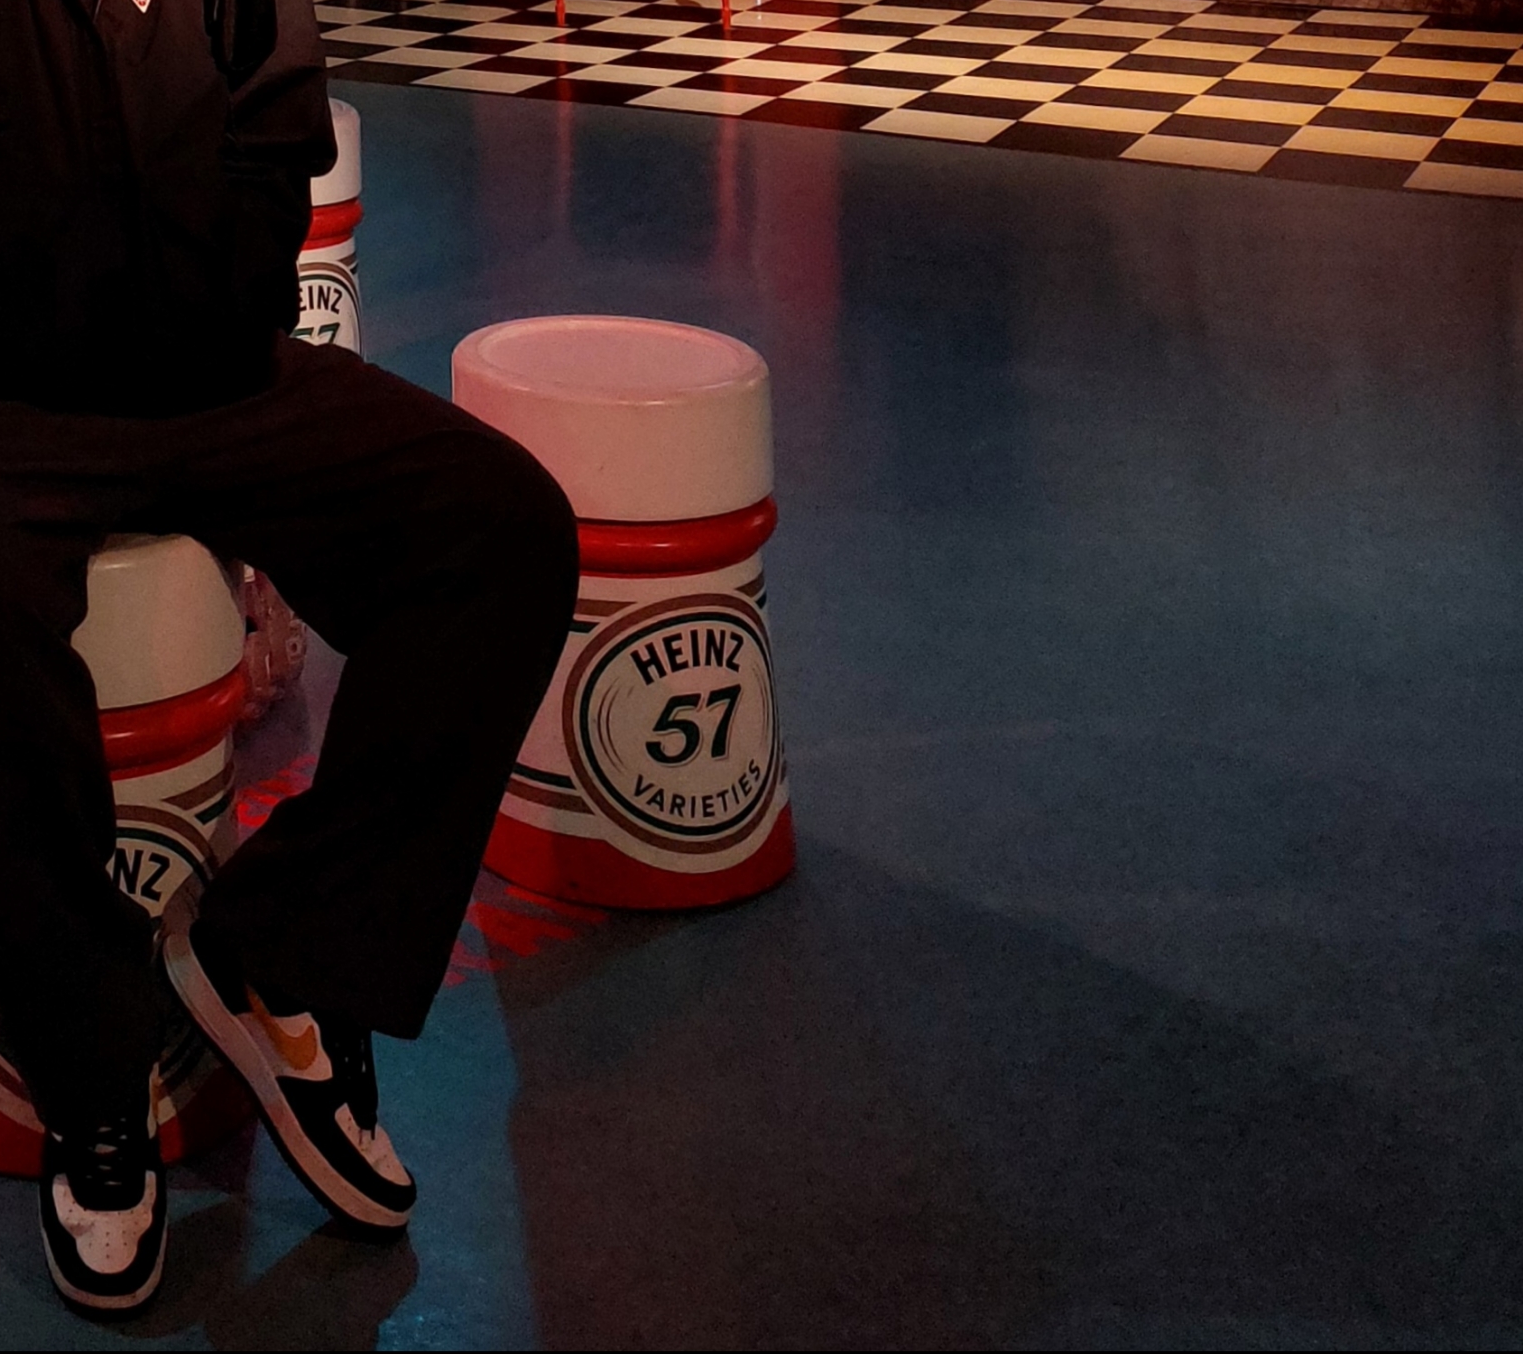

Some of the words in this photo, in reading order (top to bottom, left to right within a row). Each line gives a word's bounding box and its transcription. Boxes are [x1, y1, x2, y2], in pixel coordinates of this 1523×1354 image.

[629, 628, 745, 686] HEINZ
[645, 683, 743, 767] 57
[631, 758, 763, 819] VARIETIES
